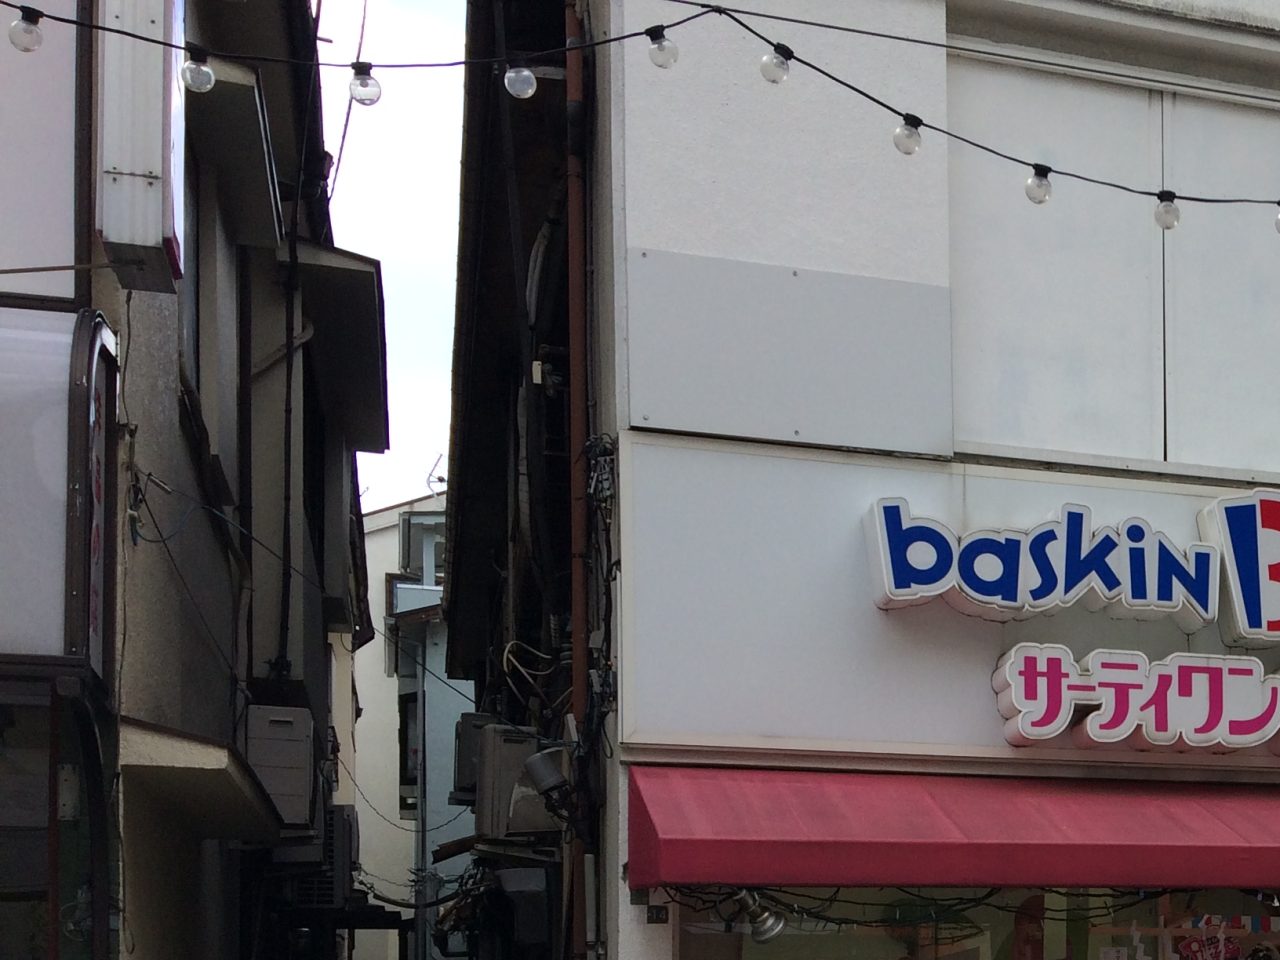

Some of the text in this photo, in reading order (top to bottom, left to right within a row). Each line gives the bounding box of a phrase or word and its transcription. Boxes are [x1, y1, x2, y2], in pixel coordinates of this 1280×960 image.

[1017, 656, 1280, 742] サーティワン
